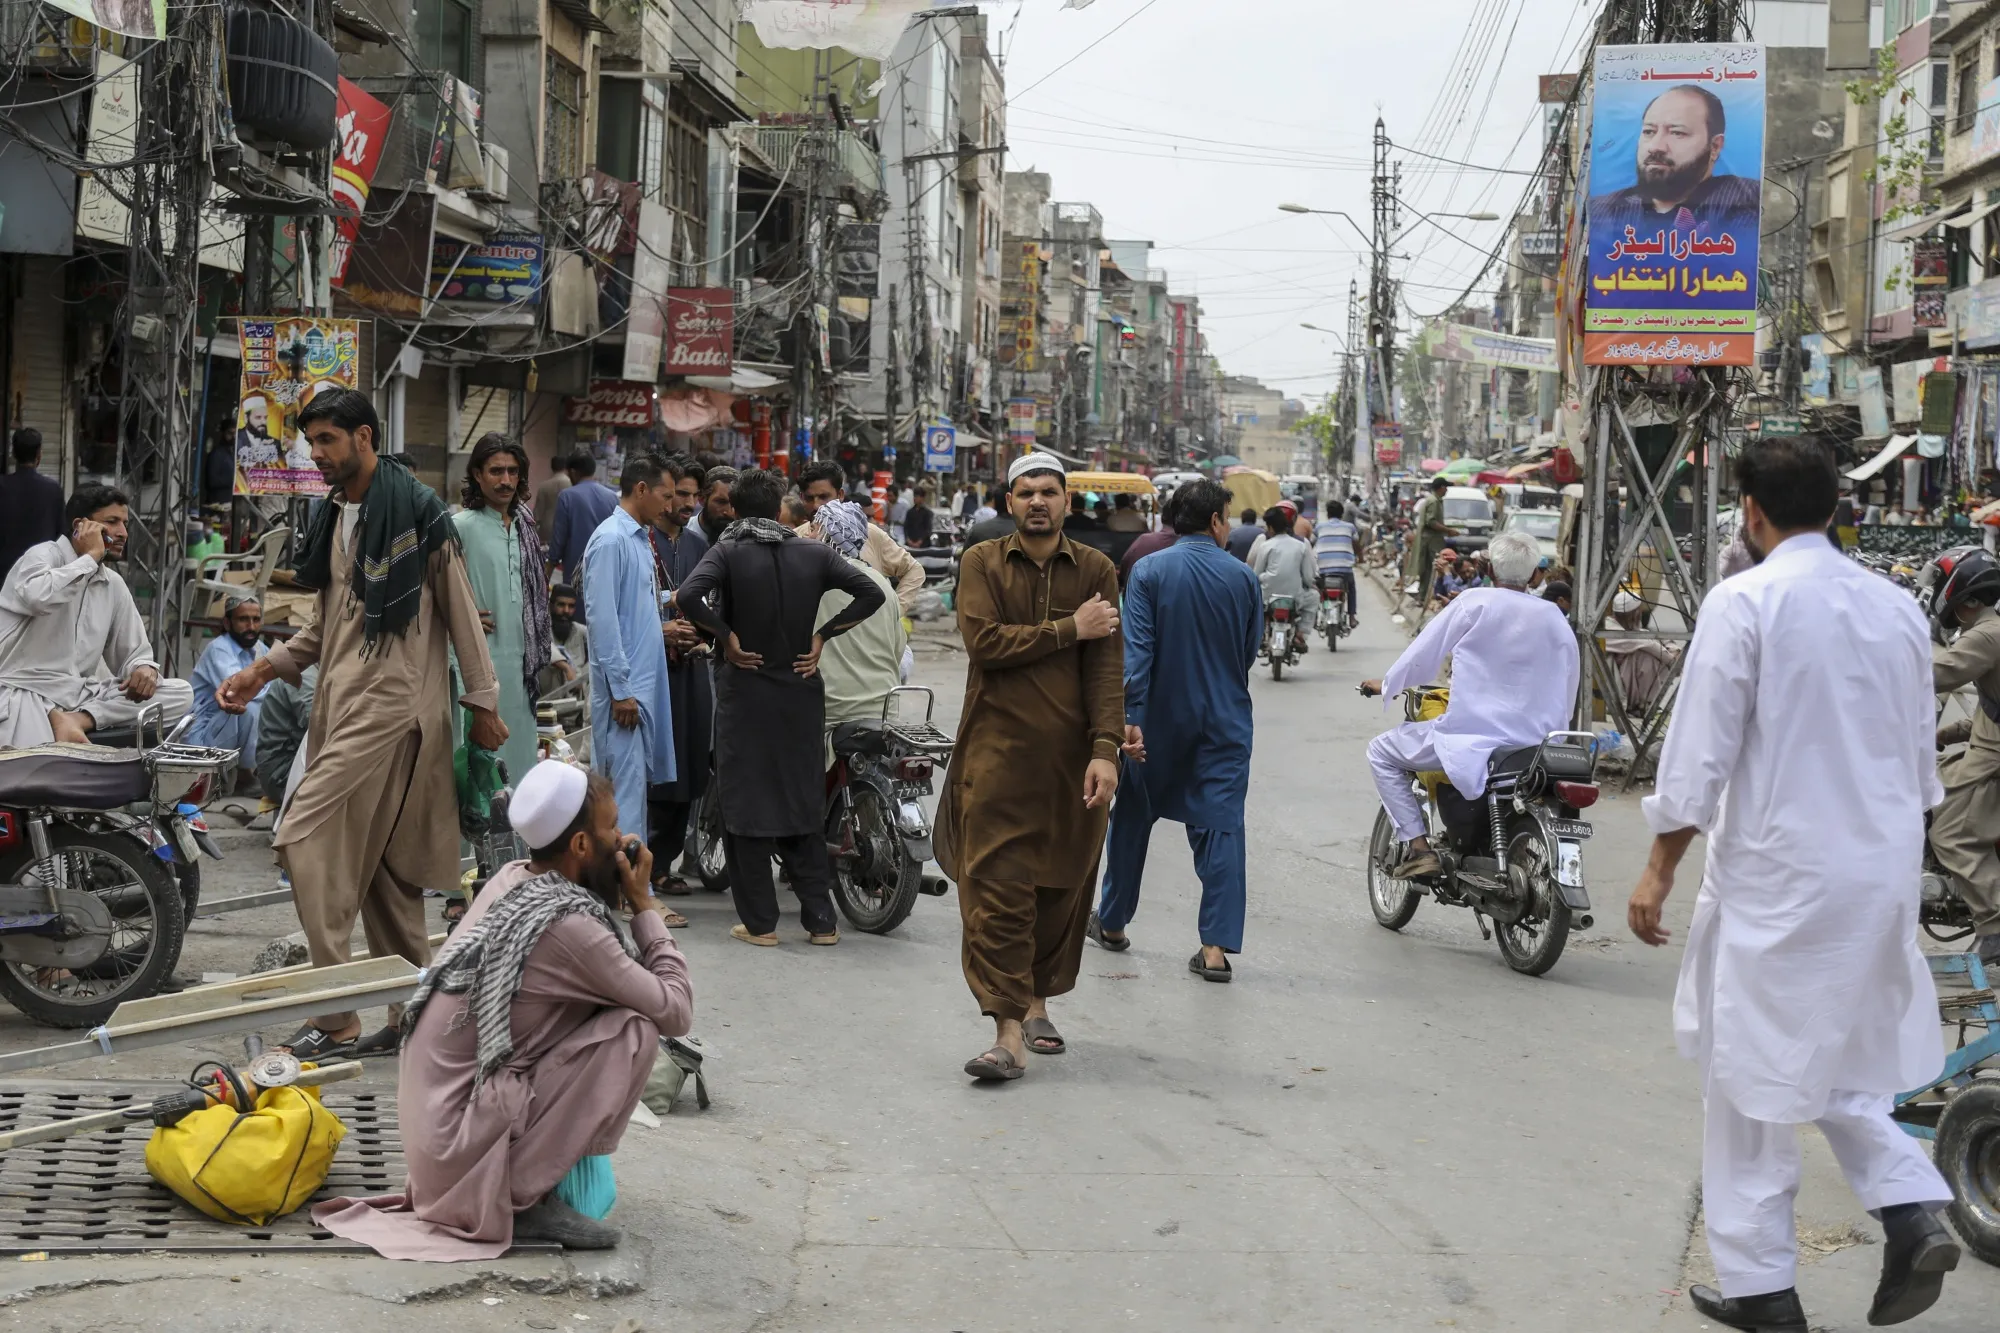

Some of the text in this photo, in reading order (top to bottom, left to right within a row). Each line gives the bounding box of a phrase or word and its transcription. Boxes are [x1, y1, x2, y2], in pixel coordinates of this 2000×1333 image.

[1641, 65, 1758, 83] مبارکباد
[1606, 224, 1736, 261] ہمارا لیڈر
[467, 244, 538, 260] entre
[1593, 266, 1748, 297] ہمارا انتخاب
[1718, 314, 1748, 328] انجمن
[263, 338, 270, 347] 3
[1701, 340, 1729, 360] کمال
[263, 350, 270, 359] 4
[669, 341, 729, 367] Bata
[263, 361, 270, 371] 5
[568, 403, 649, 425] Bata
[1550, 752, 1588, 762] HONDA
[897, 786, 928, 798] 7705
[1572, 824, 1593, 836] 5602
